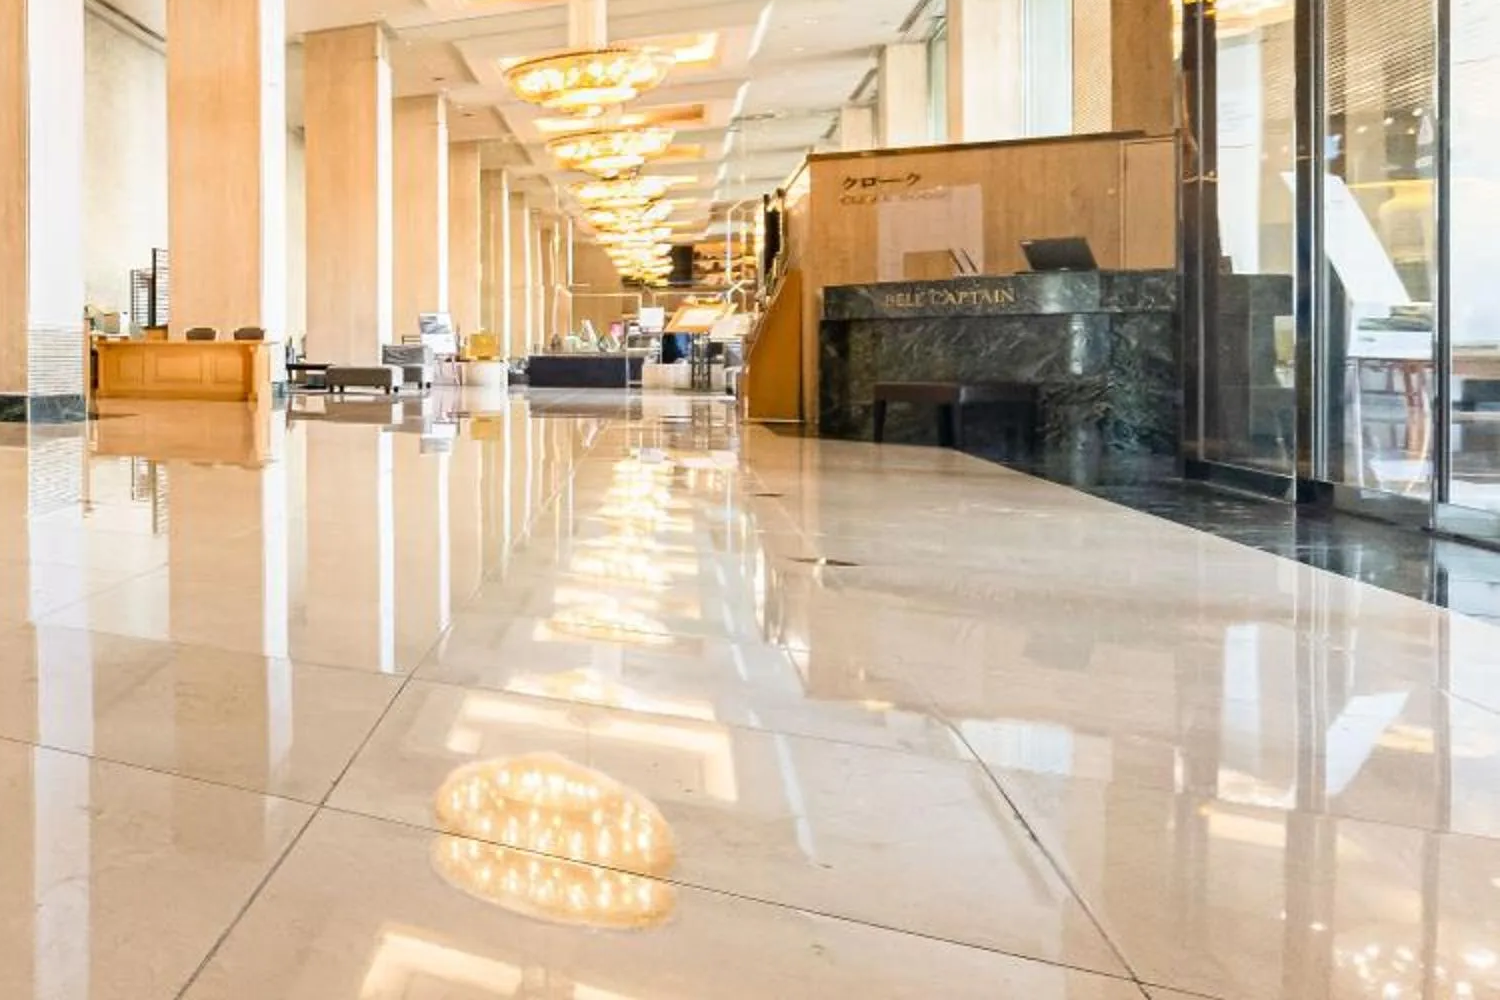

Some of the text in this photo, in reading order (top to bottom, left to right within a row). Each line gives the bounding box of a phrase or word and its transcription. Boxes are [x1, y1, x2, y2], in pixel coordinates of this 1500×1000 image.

[842, 173, 922, 191] クローク
[928, 287, 1016, 306] CAPTAIN
